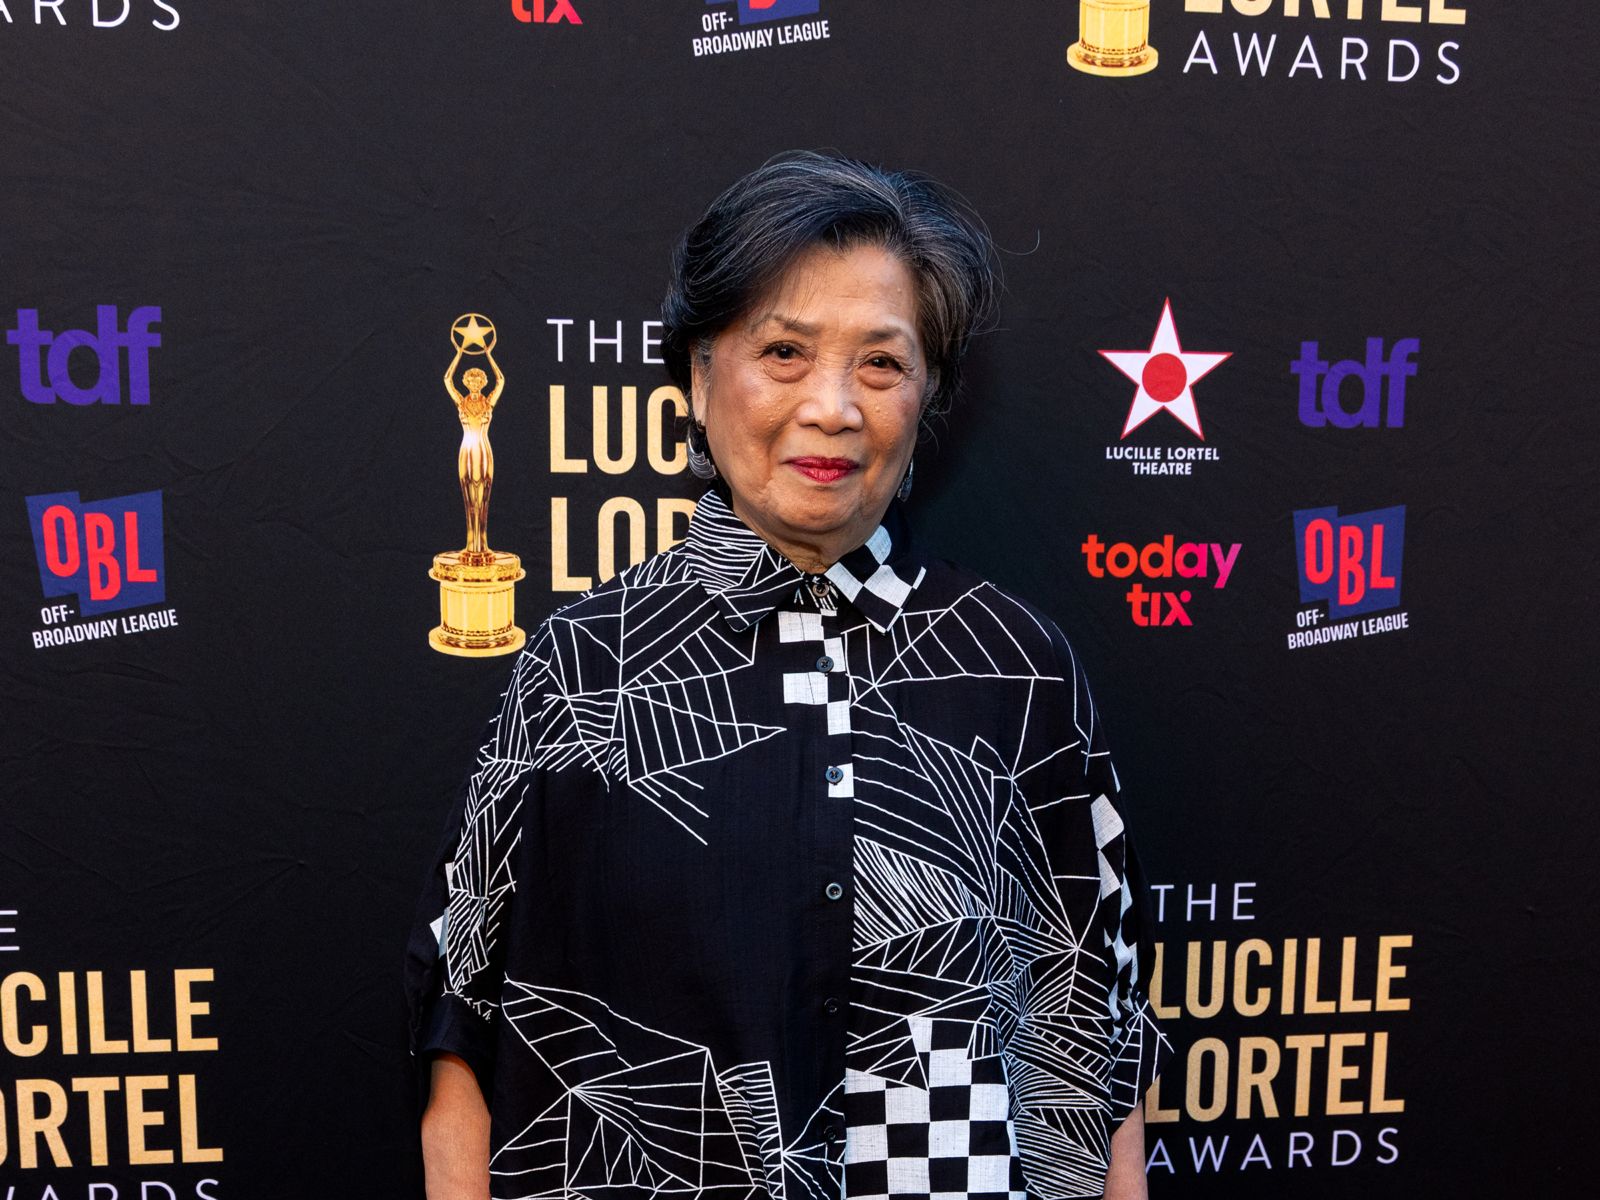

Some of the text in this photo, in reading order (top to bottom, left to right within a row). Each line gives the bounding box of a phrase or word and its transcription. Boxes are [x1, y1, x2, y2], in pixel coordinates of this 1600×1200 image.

[692, 20, 830, 57] BROADWAY LEAGUE
[702, 11, 734, 32] OFF-
[1182, 30, 1460, 85] AWARDS
[6, 304, 162, 406] tdf
[546, 318, 665, 364] THE
[1290, 336, 1420, 429] tdf
[1105, 446, 1220, 461] LUCILLE LORTEL
[1132, 462, 1192, 475] THEATRE
[42, 504, 158, 601] OBL
[1081, 533, 1243, 589] today
[1304, 518, 1396, 606] OBL
[40, 604, 75, 625] OFF-
[1126, 583, 1193, 627] tix
[1296, 608, 1325, 627] OFF-
[32, 608, 178, 649] BROADWAY LEAGUE
[1287, 612, 1409, 650] BROADWAY LEAGUE
[1150, 882, 1257, 922] THE
[1149, 934, 1414, 1020] LUCILLE
[0, 1074, 224, 1169] RTEL
[1145, 1126, 1399, 1175] AWARDS
